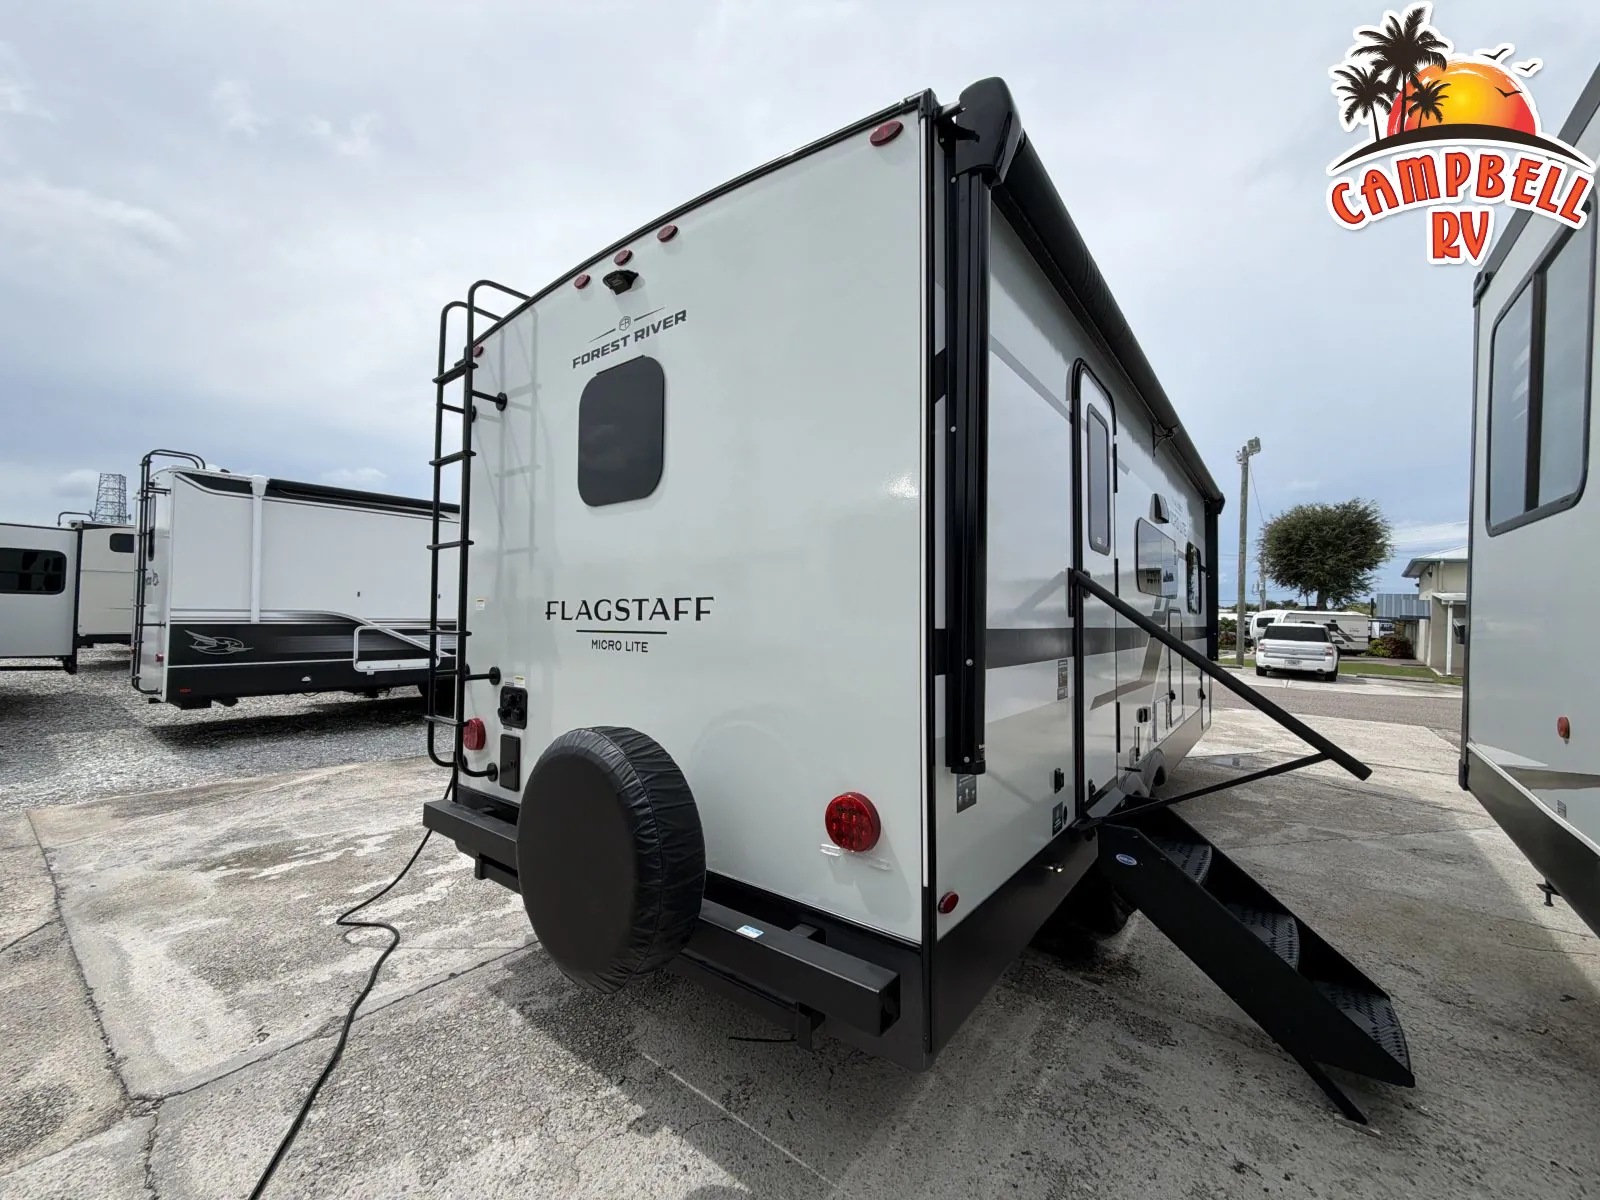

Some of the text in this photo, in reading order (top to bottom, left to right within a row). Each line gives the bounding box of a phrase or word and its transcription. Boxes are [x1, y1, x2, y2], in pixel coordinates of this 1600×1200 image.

[572, 309, 687, 369] FOREST RIVER
[545, 596, 715, 622] FLAGSTAFF
[591, 639, 649, 653] MICRO LITE
